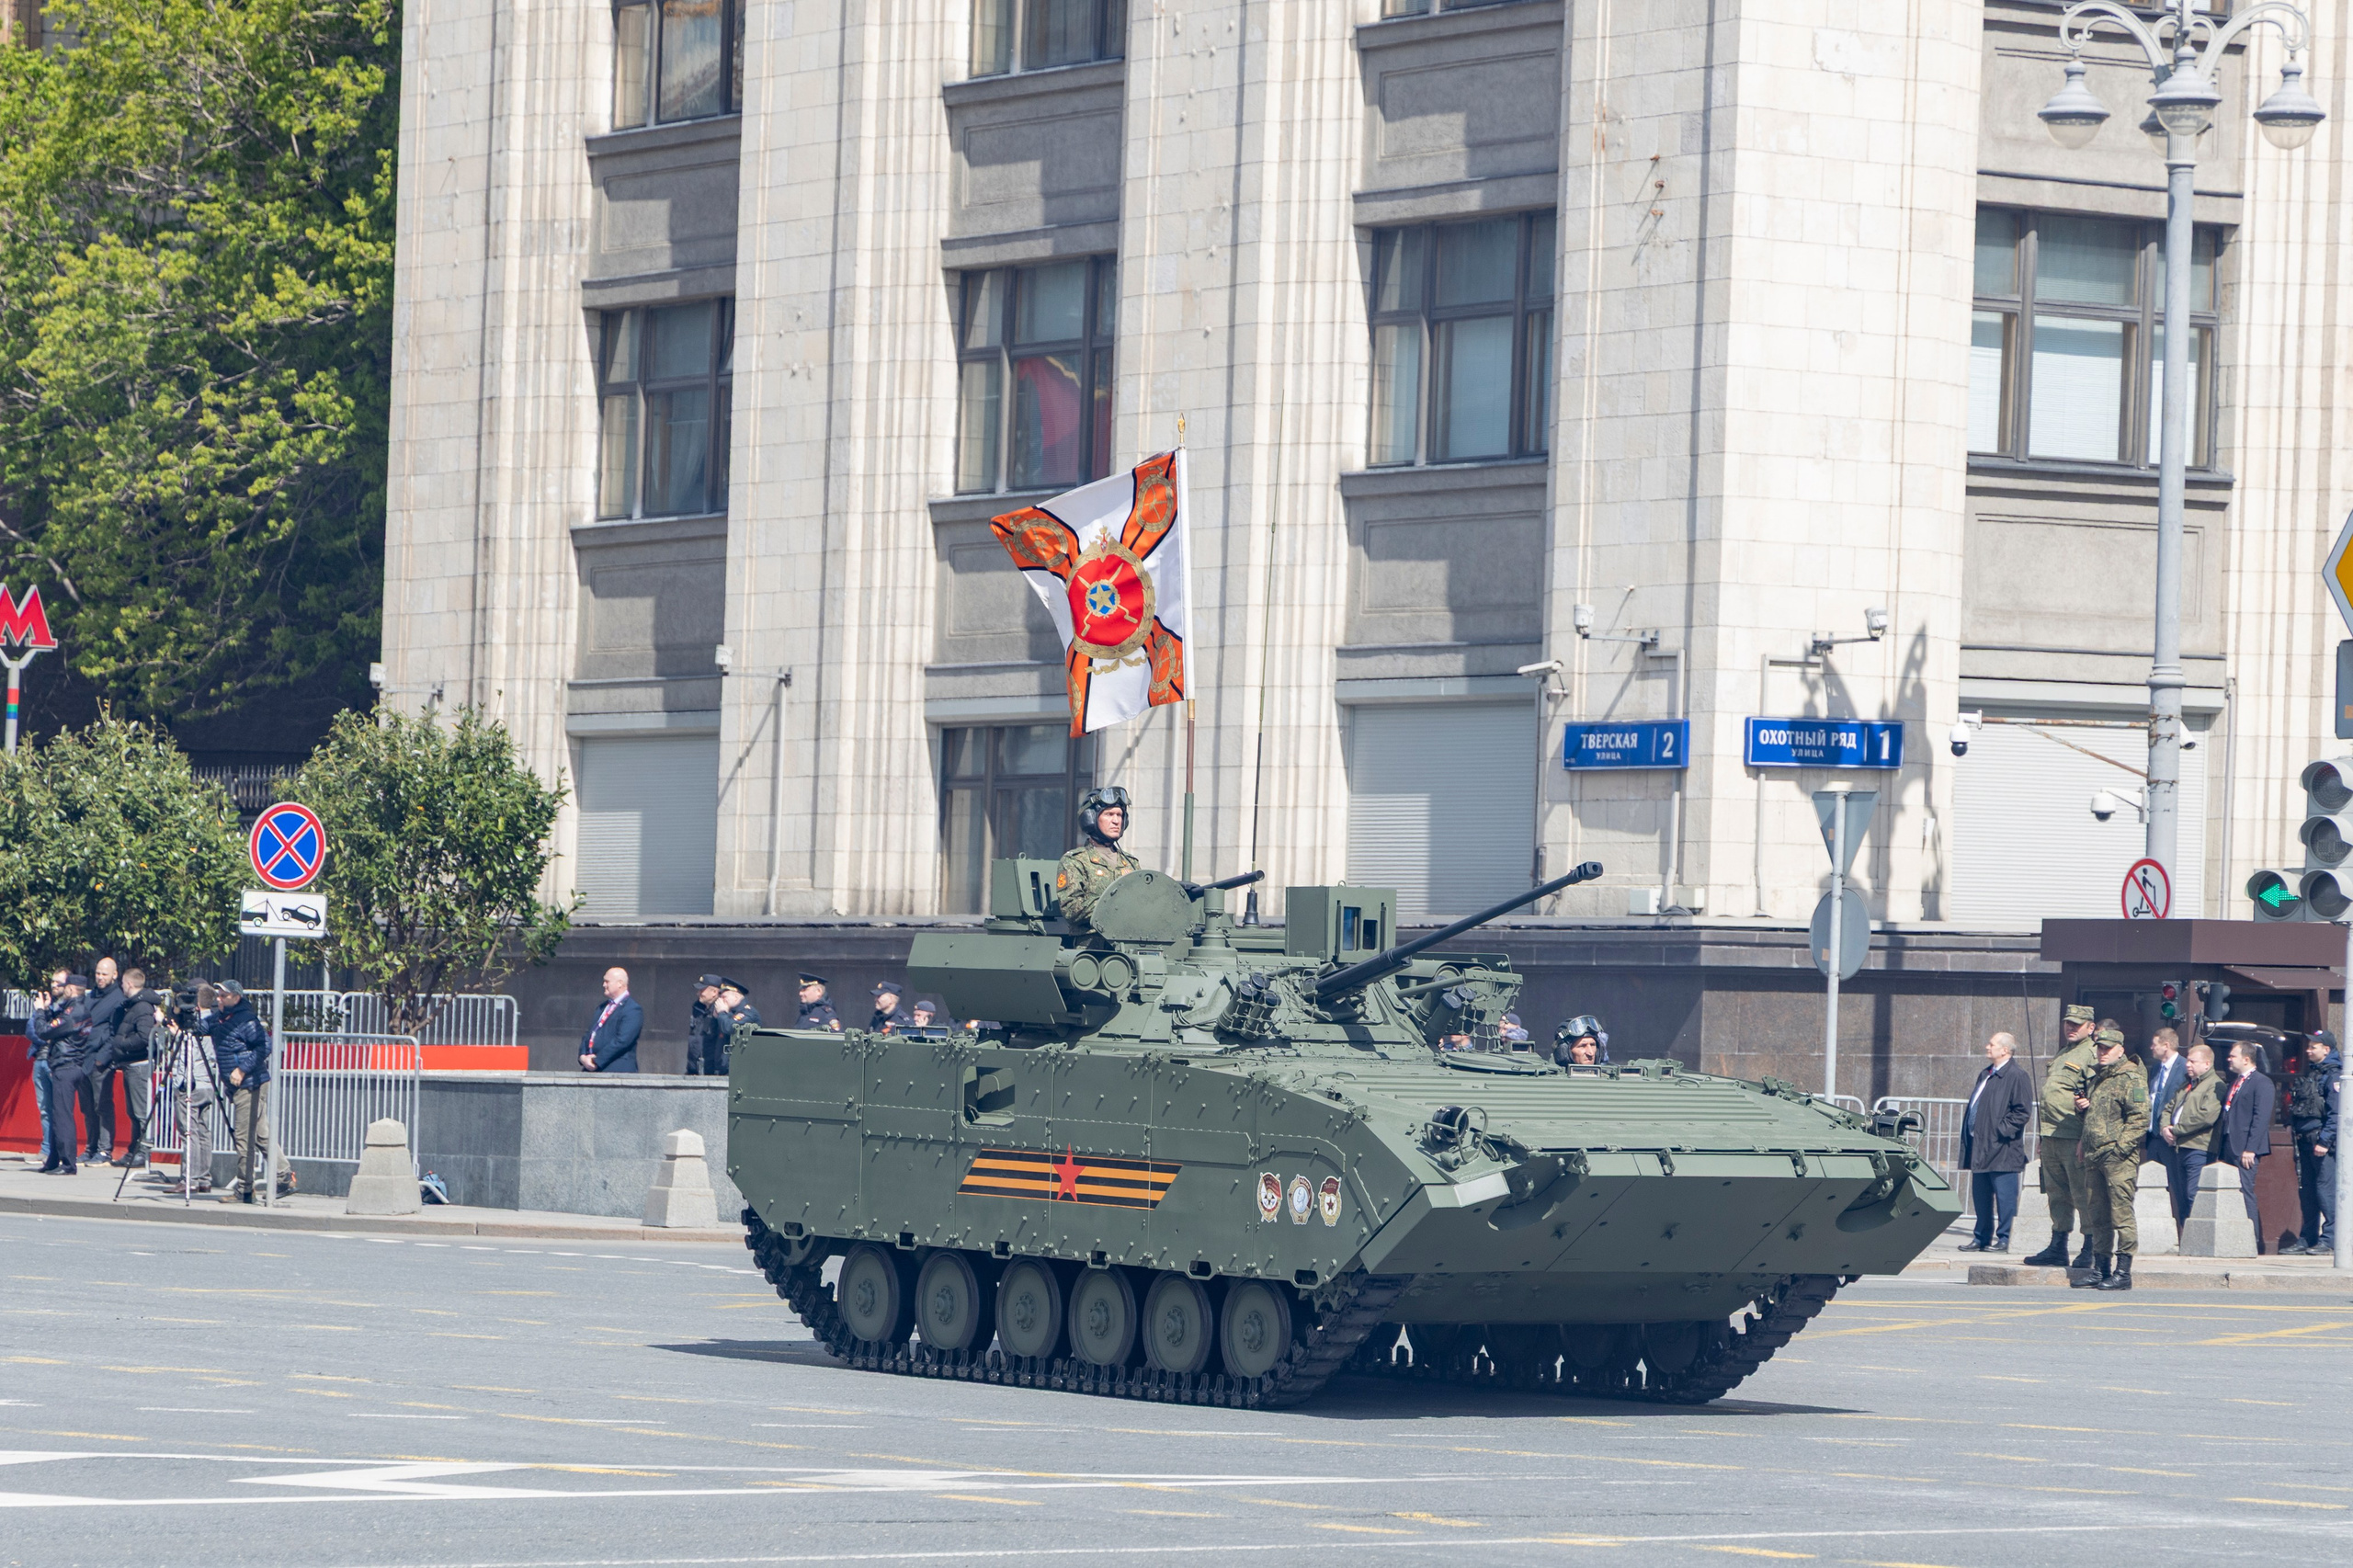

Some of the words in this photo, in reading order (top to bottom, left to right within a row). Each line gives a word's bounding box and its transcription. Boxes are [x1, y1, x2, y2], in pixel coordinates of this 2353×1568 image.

[1581, 733, 1638, 749] ТВЕРСКАЯ
[1662, 732, 1674, 757] 2
[1758, 729, 1826, 746] ОХОТНЫЙ
[1831, 732, 1857, 749] РЯД
[1879, 730, 1891, 759] 1
[1596, 752, 1621, 760] УЛИЦА
[1791, 748, 1824, 758] УЛИЦА
